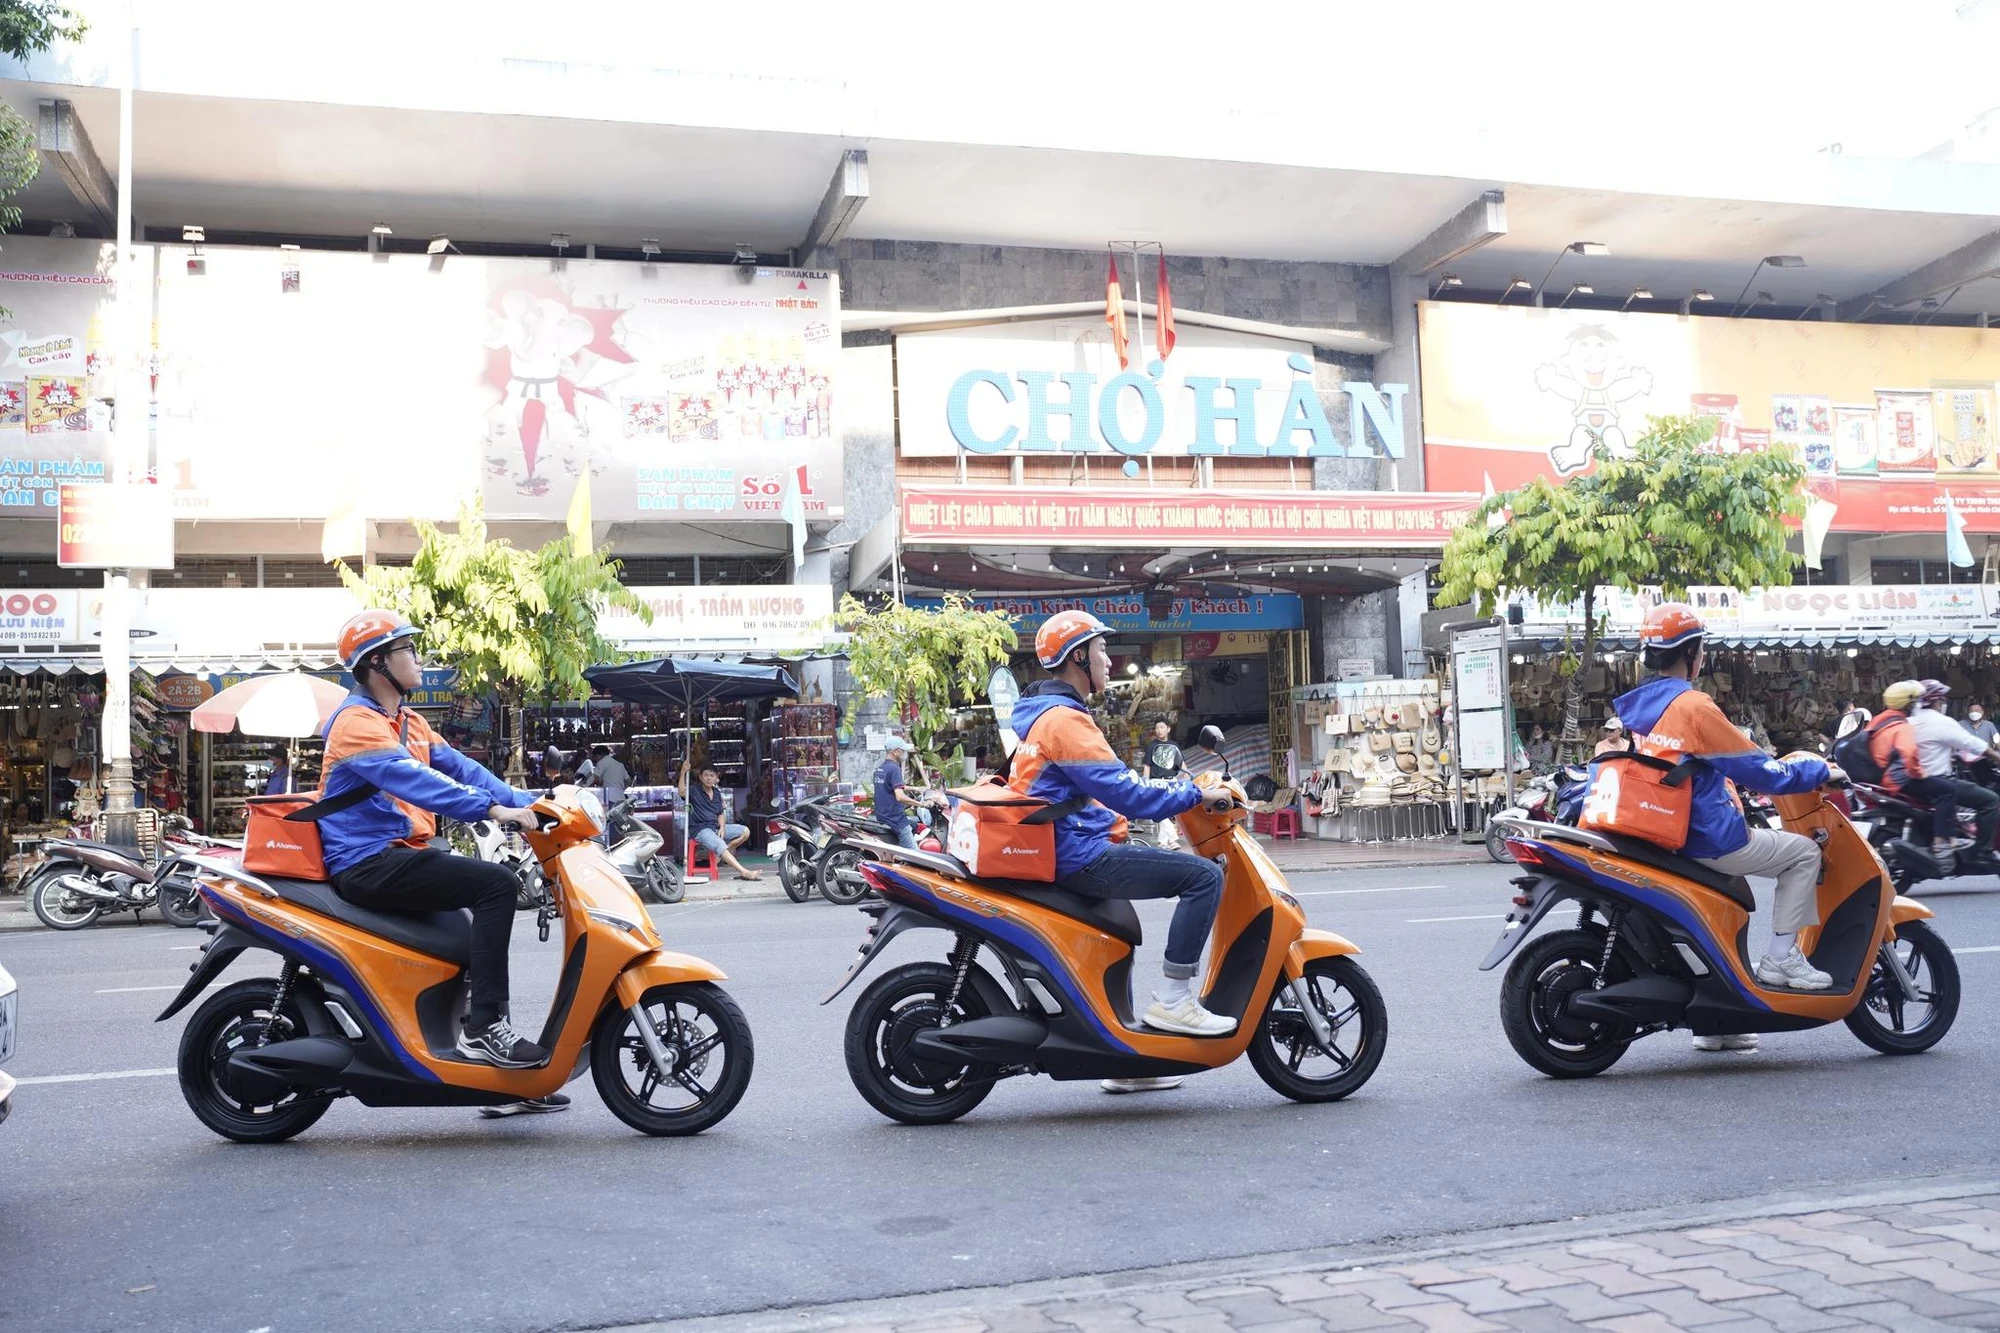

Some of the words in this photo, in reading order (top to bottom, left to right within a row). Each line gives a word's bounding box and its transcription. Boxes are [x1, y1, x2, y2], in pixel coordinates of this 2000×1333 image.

[68, 276, 91, 285] CAO
[775, 270, 829, 280] FUMAKILLA
[28, 357, 49, 365] Cao
[947, 359, 1165, 477] CHỢ
[1184, 352, 1409, 460] HÀN
[39, 454, 105, 475] PHẨM
[909, 500, 938, 529] NHIỆT
[941, 501, 961, 530] LIỆT
[964, 501, 990, 527] CHÀO
[1040, 502, 1066, 531] NIỆM
[1068, 507, 1080, 527] 77
[1082, 502, 1105, 527] NĂM
[1107, 503, 1133, 527] NGÀY
[1135, 501, 1161, 529] QUỐC
[1163, 504, 1195, 528] KHÁNH
[1197, 504, 1222, 528] NƯỚC
[1224, 504, 1249, 532] CỘNG
[1272, 505, 1285, 529] XÃ
[1286, 505, 1302, 532] HỘI
[1304, 503, 1322, 529] CHỦ
[1323, 506, 1351, 530] NGHĨA
[1352, 506, 1371, 533] VIỆT
[1372, 509, 1395, 530] NAM
[700, 591, 744, 616] TRẦM
[749, 597, 805, 616] HƯƠNG
[993, 599, 1035, 614] Hàn
[1041, 598, 1087, 614] Kính
[1094, 599, 1142, 615] Chào
[1190, 599, 1249, 615] Khách
[1762, 593, 1850, 616] NGỌC
[1856, 587, 1918, 610] LIÊN
[31, 617, 65, 629] NIỆM
[1109, 618, 1140, 629] Han
[1147, 618, 1192, 629] Market
[168, 684, 202, 696] 2A-2B
[1591, 860, 1641, 879] FELIZ
